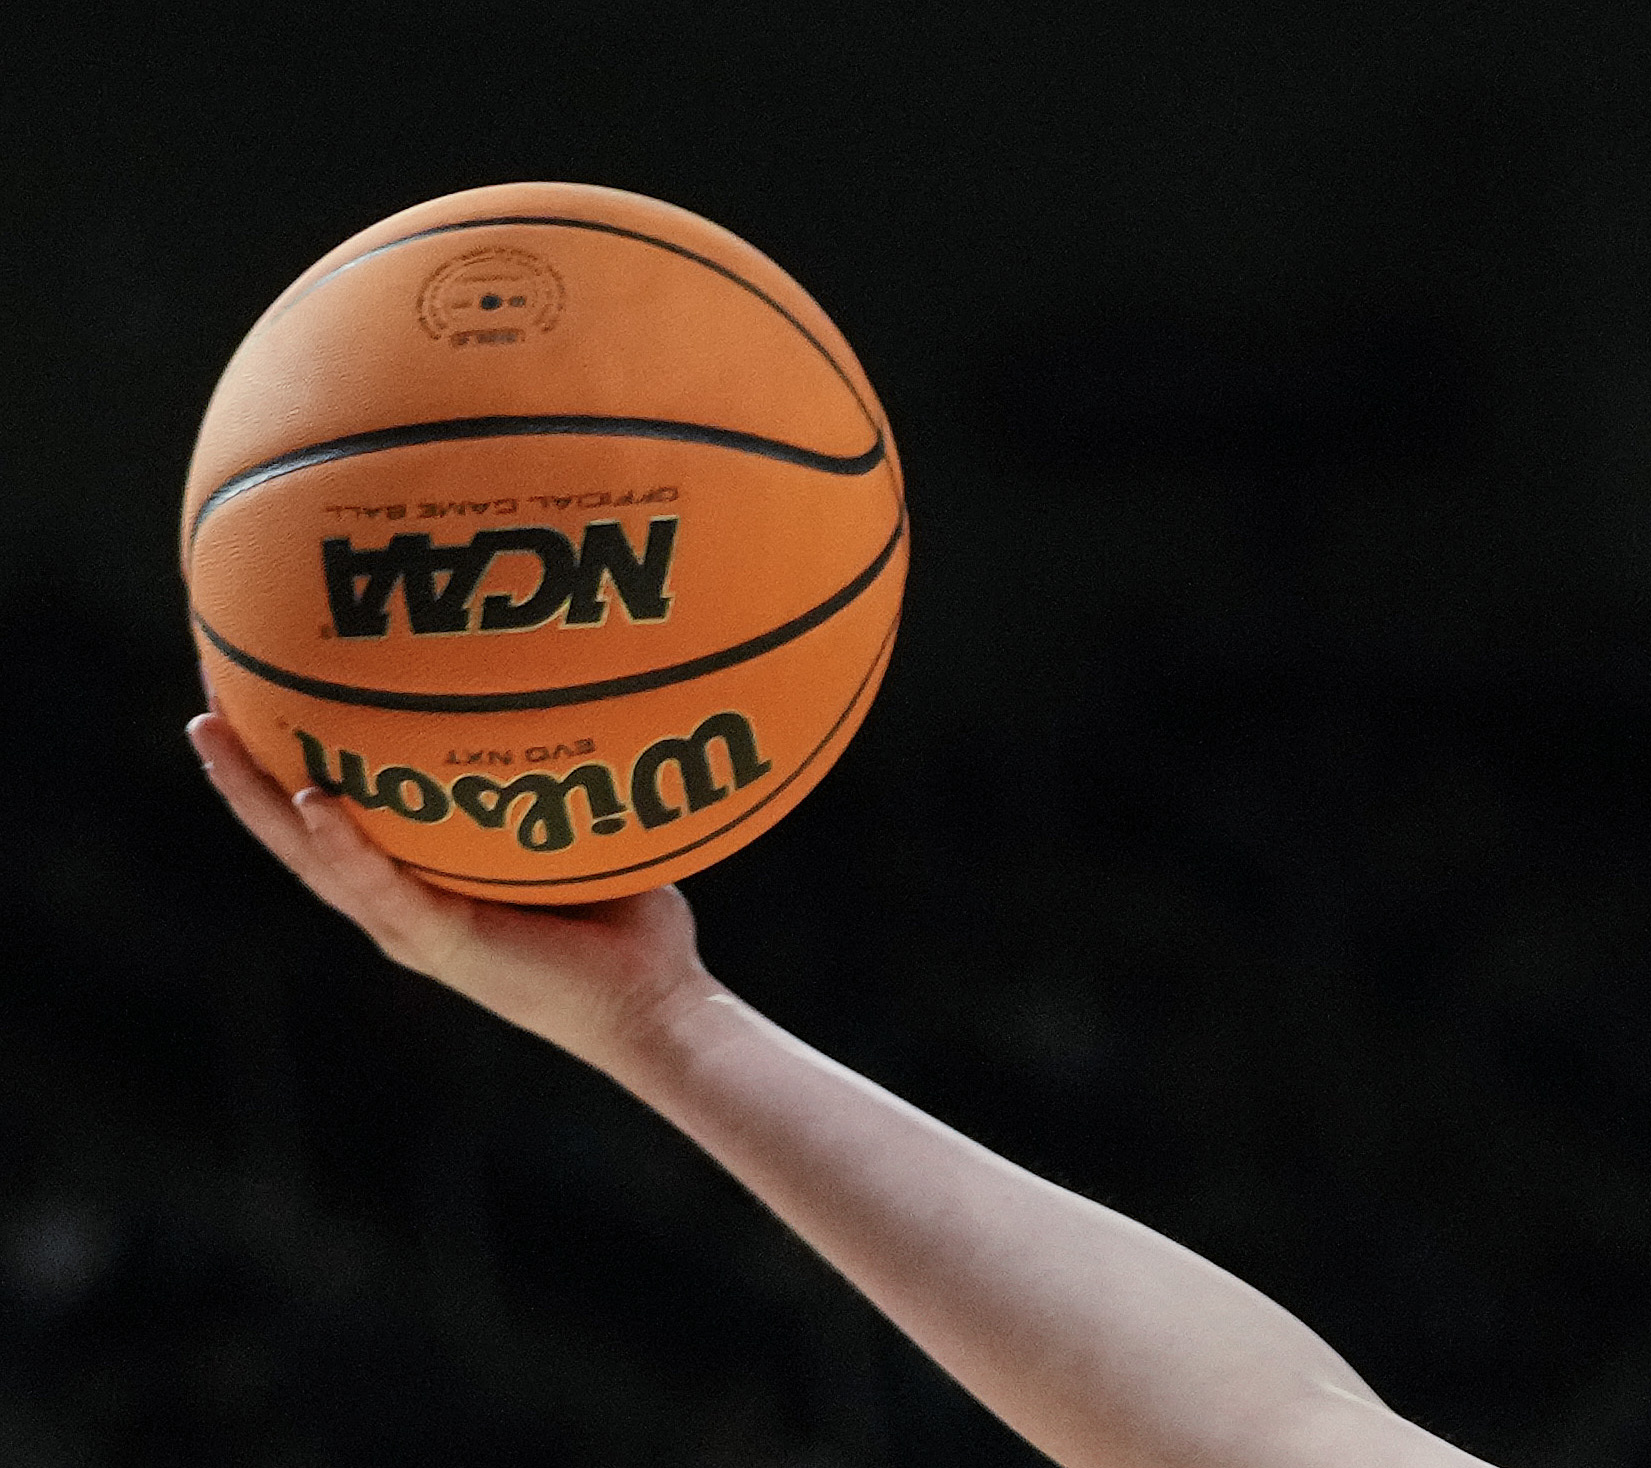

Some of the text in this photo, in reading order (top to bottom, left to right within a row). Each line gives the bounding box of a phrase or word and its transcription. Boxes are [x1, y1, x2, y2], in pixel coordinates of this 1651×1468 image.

[325, 486, 679, 520] OFFICIAL GAME BALL
[322, 516, 679, 640] NCAA
[295, 711, 773, 852] Wilson
[446, 738, 597, 765] EVO NXT
